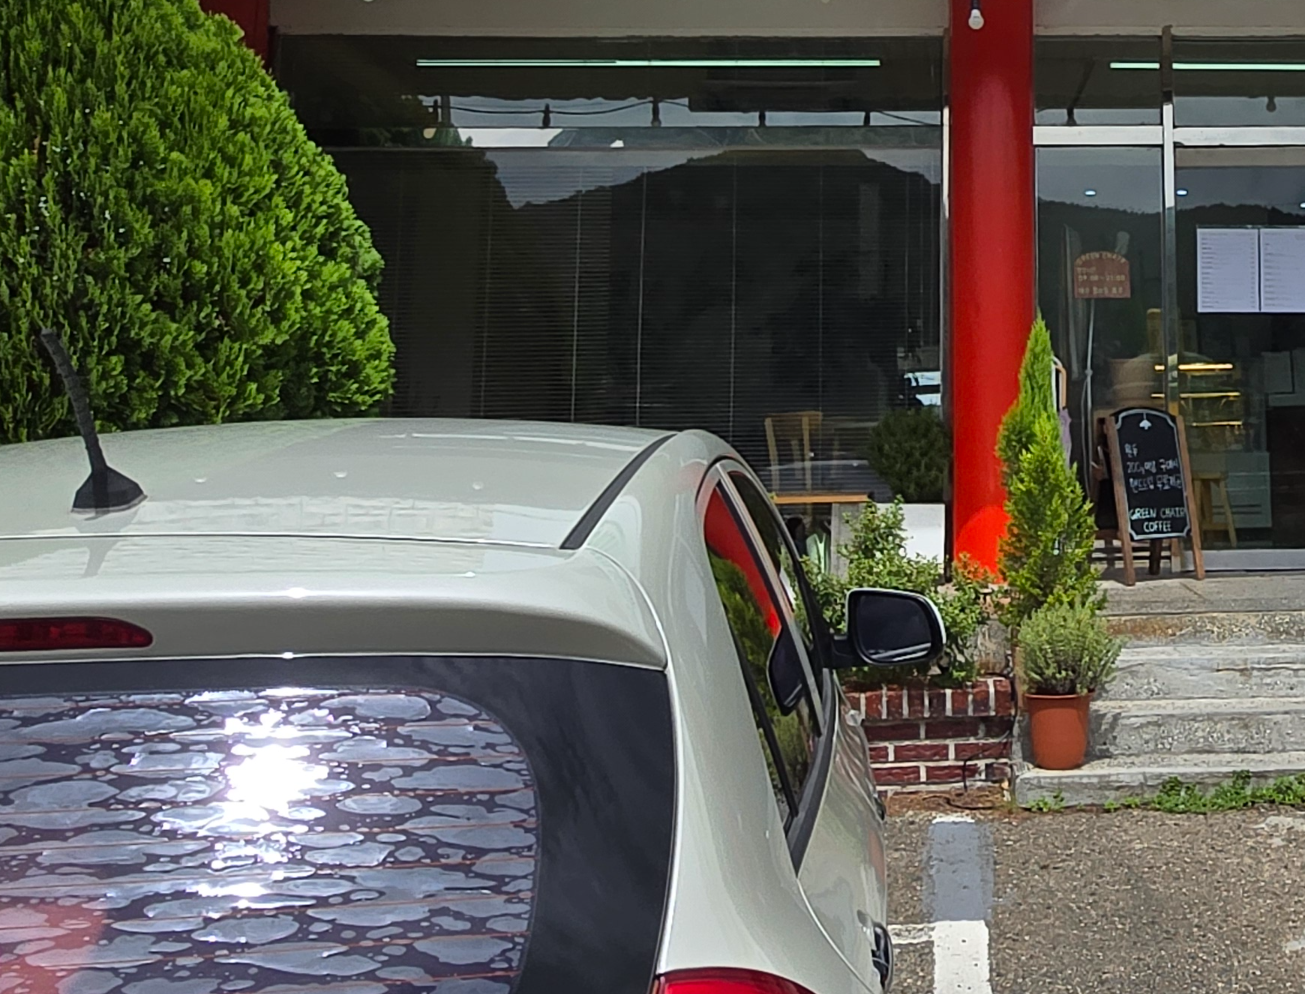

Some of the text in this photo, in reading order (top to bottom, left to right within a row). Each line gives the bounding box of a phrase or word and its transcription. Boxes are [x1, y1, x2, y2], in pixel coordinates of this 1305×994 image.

[1129, 506, 1186, 520] GREEN CHAIR
[1143, 520, 1172, 532] COFFEE
